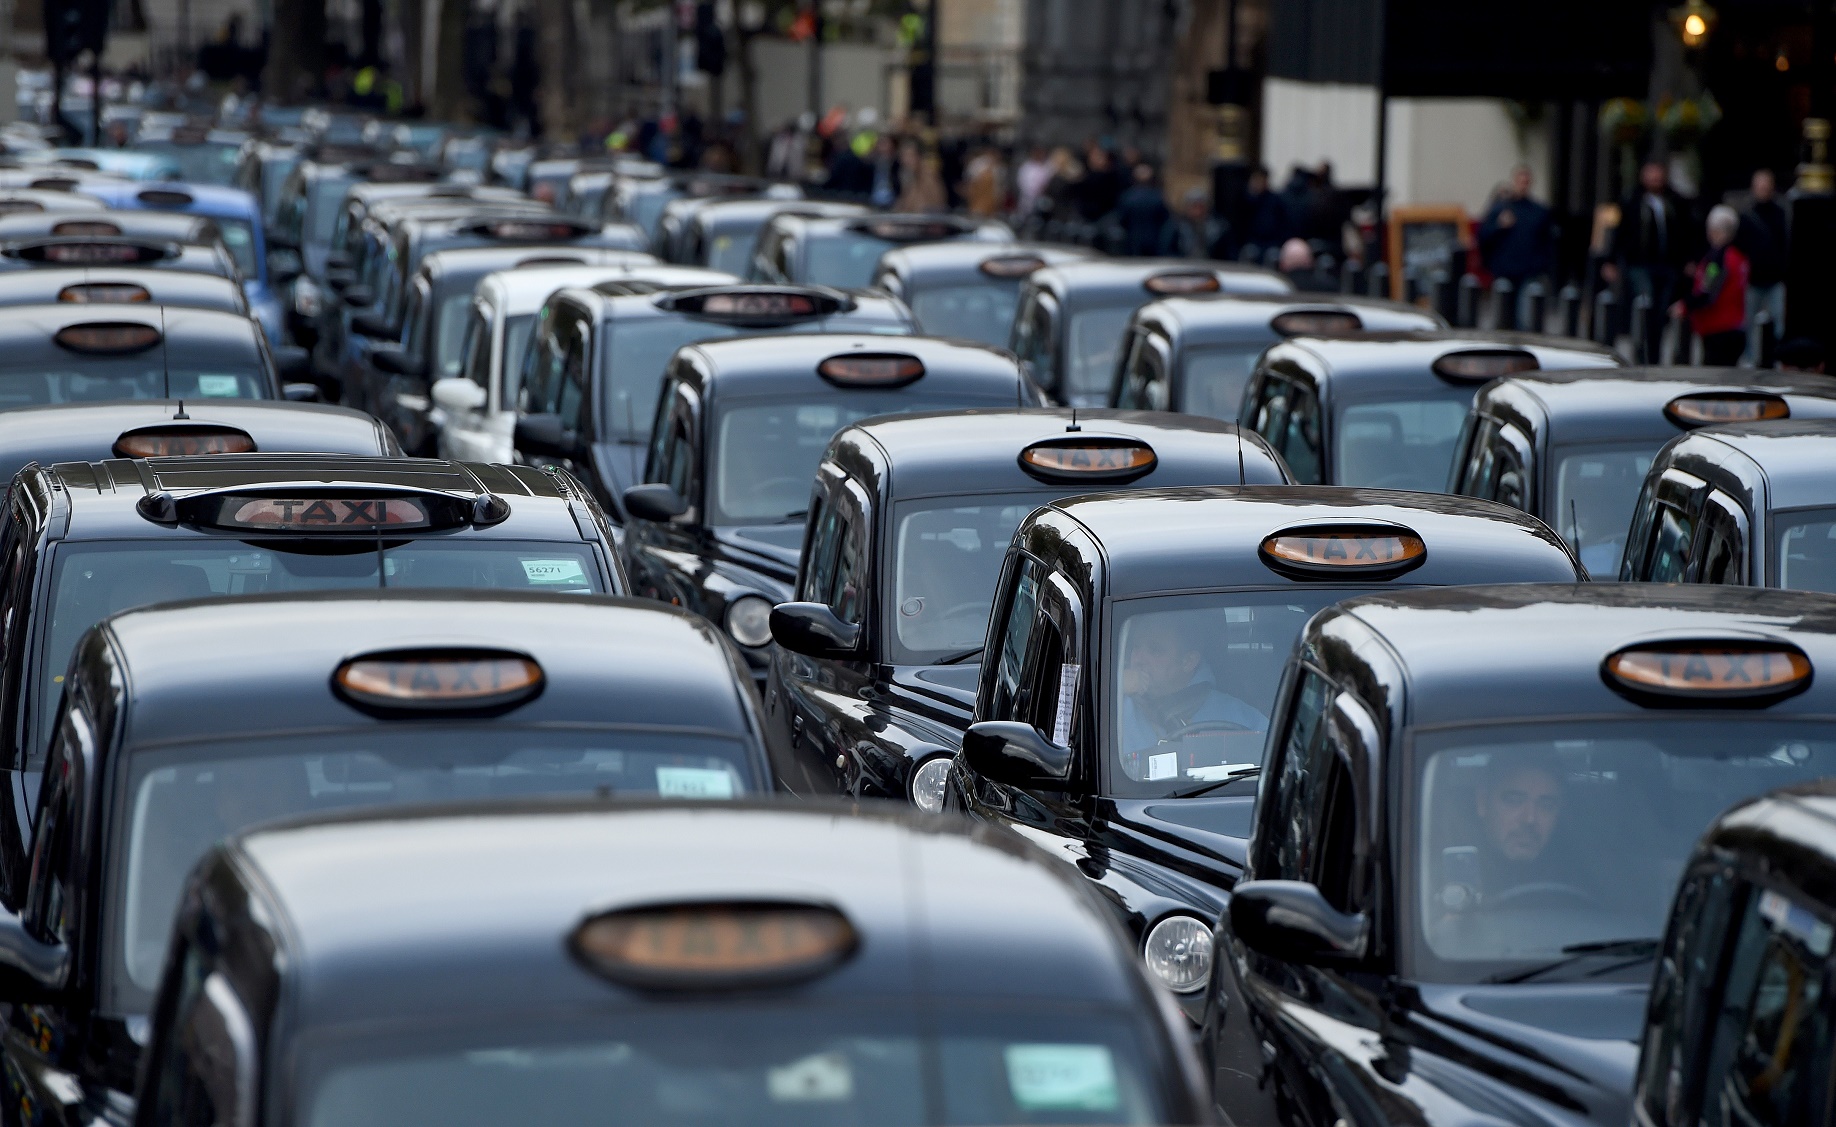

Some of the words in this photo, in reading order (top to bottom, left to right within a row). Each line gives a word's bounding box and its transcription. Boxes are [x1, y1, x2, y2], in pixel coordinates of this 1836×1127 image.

[1696, 400, 1766, 417] TAXI
[1054, 447, 1129, 467] TAXI
[273, 500, 387, 523] TAXI
[1299, 536, 1393, 560] TAXI
[381, 661, 502, 691] TAXI
[1654, 651, 1772, 682] TAXI
